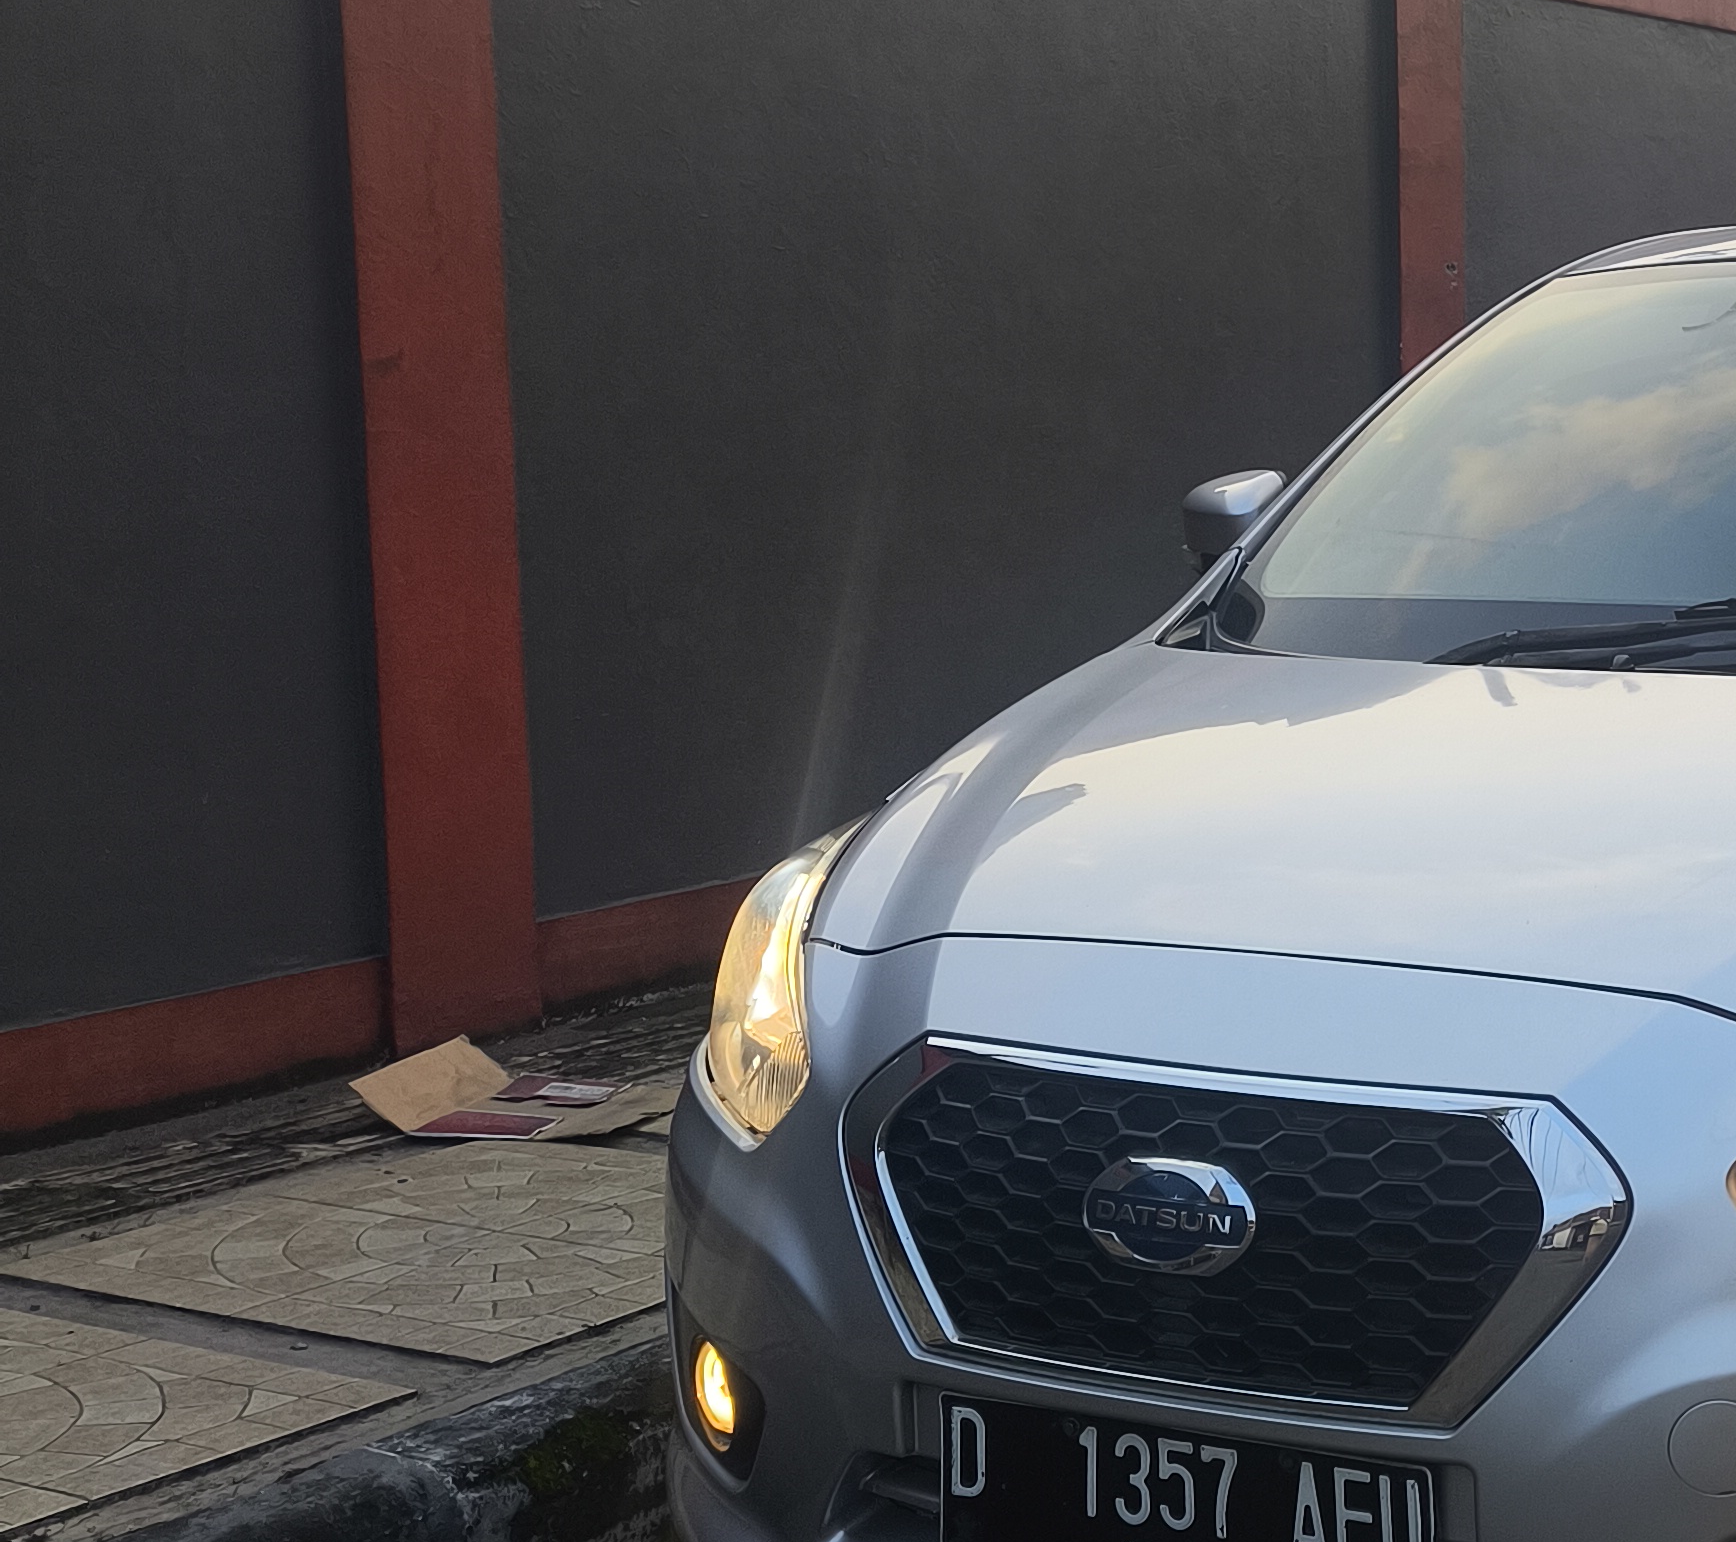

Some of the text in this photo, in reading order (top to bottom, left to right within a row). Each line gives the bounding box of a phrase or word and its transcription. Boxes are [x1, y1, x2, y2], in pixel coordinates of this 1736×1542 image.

[1095, 1199, 1232, 1235] DATSUN
[951, 1407, 986, 1497] D
[1078, 1426, 1238, 1539] 1357
